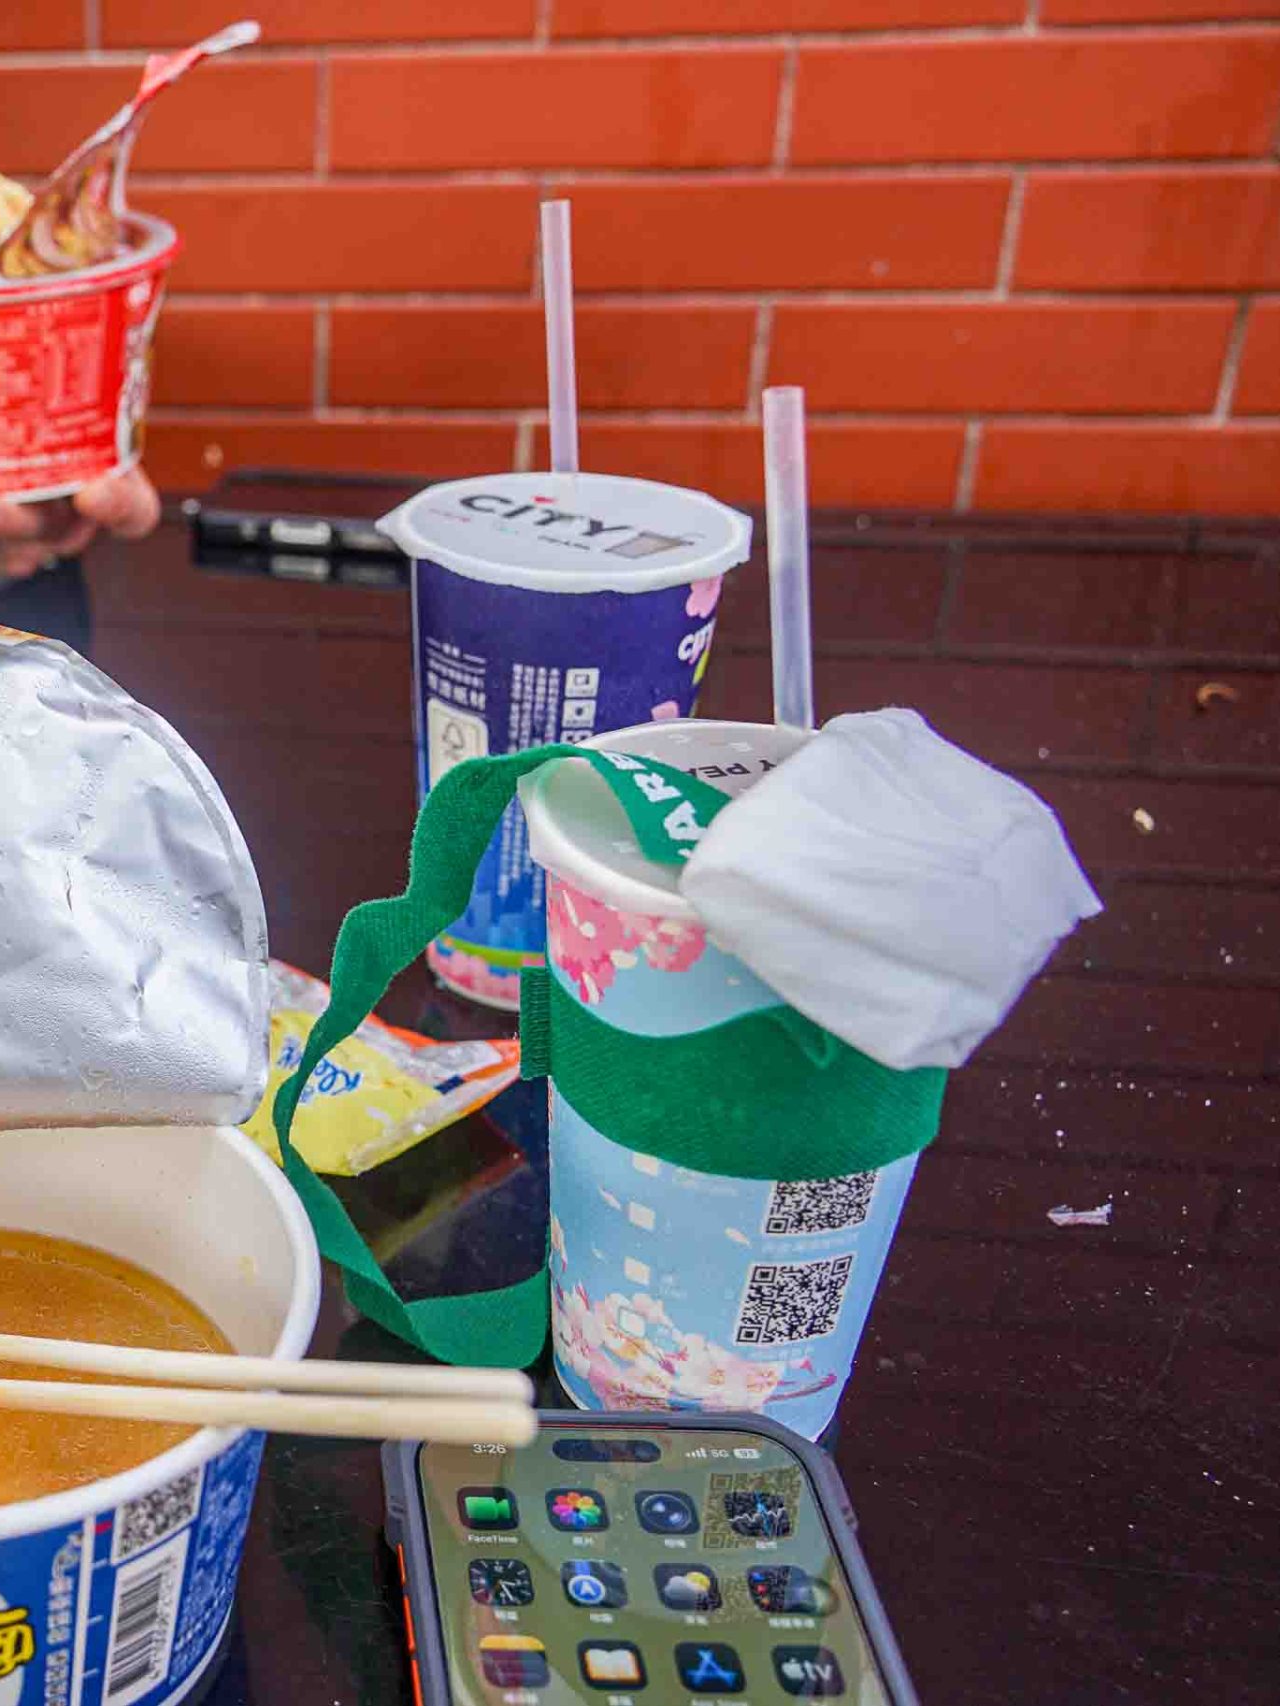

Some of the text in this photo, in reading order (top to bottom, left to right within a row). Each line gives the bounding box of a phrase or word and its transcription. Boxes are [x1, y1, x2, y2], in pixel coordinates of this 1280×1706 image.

[459, 493, 634, 537] CITY
[599, 750, 707, 858] ARB
[472, 1443, 507, 1455] 3:26
[467, 1534, 519, 1544] FaceTime
